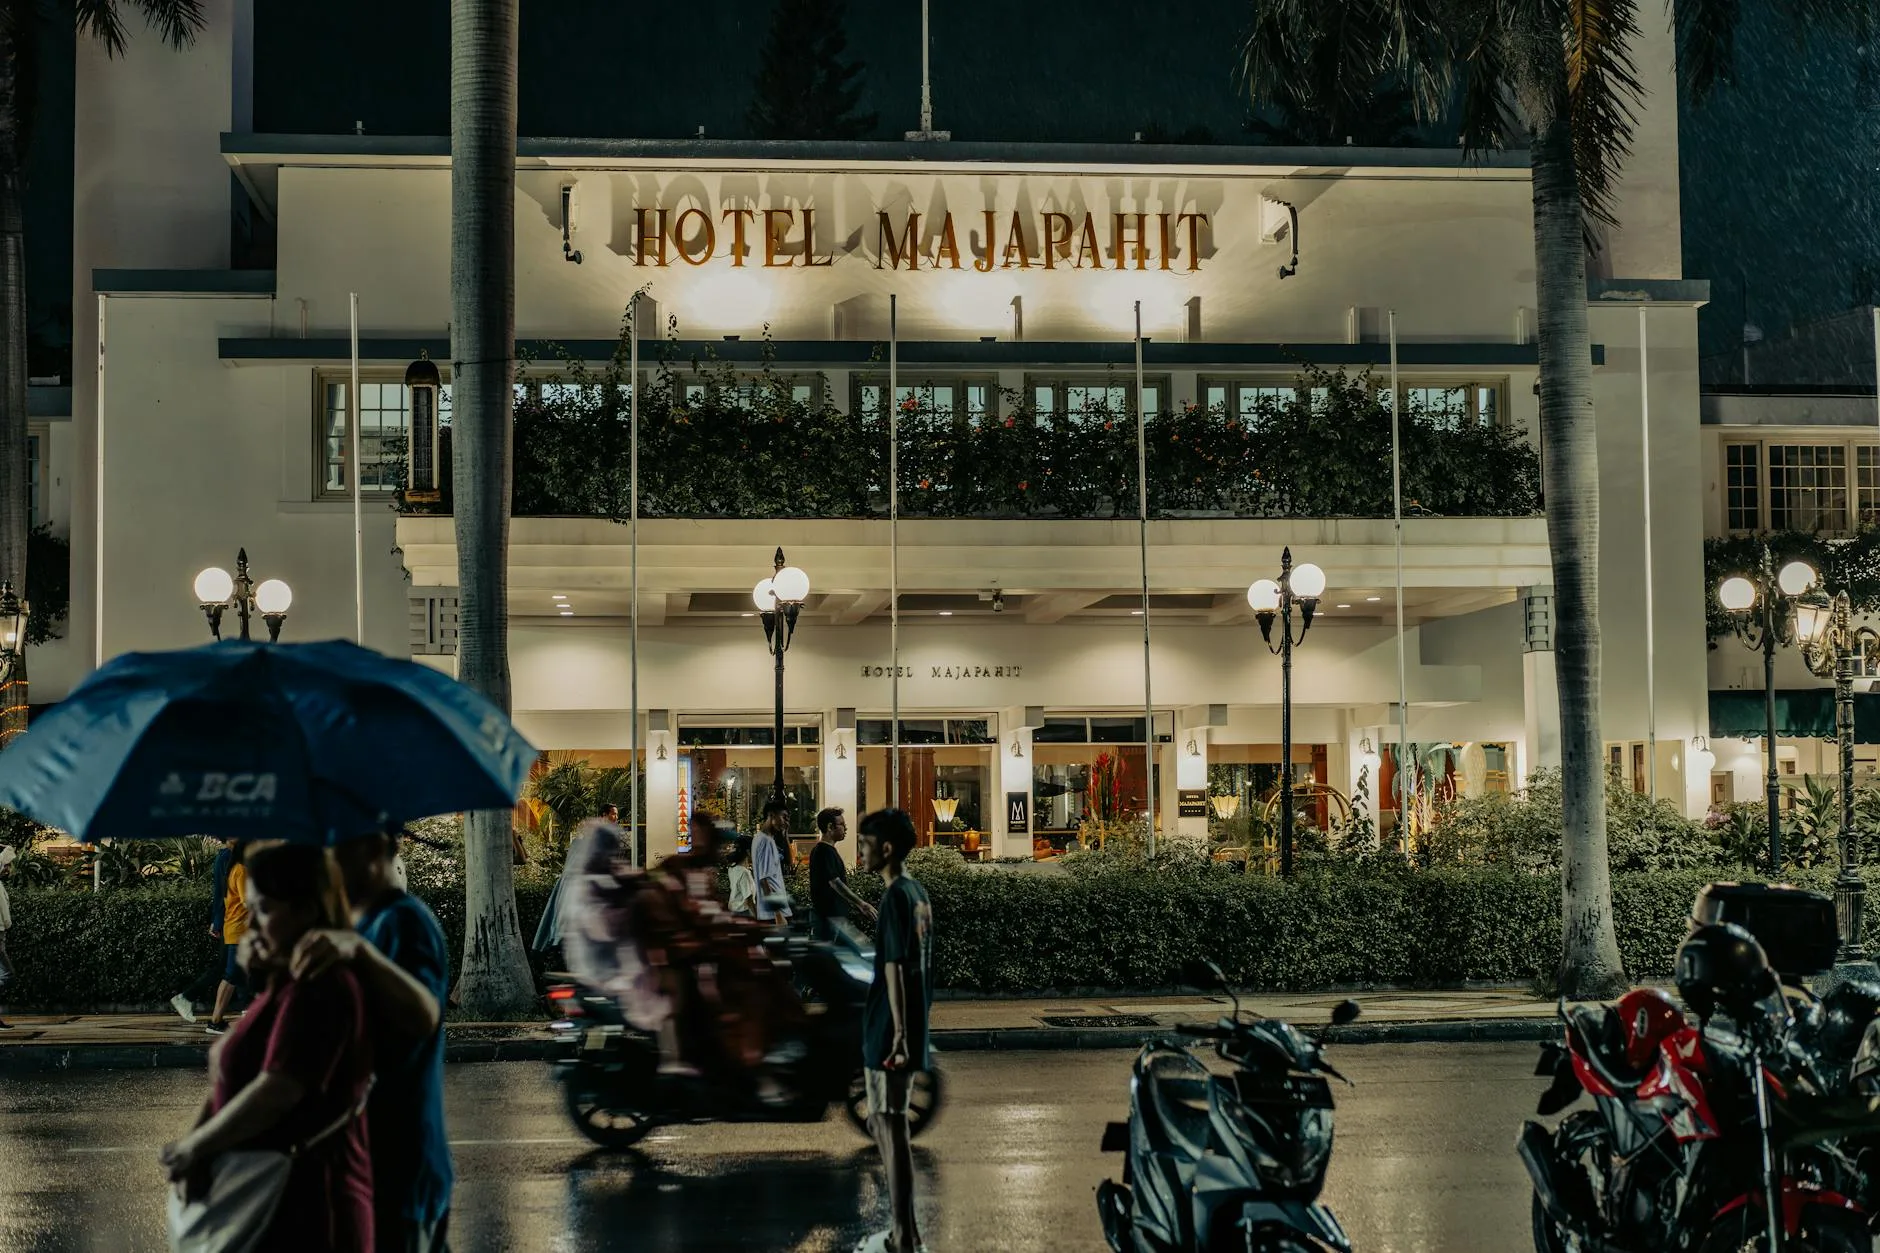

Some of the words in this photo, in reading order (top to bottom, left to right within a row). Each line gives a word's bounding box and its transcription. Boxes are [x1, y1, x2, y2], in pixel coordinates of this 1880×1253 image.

[633, 207, 834, 267] HOTEL
[877, 210, 1208, 271] MAJAPAHIT
[861, 665, 913, 679] HOTEL
[931, 665, 1023, 680] MAJAPAHIT
[196, 772, 277, 802] BCA
